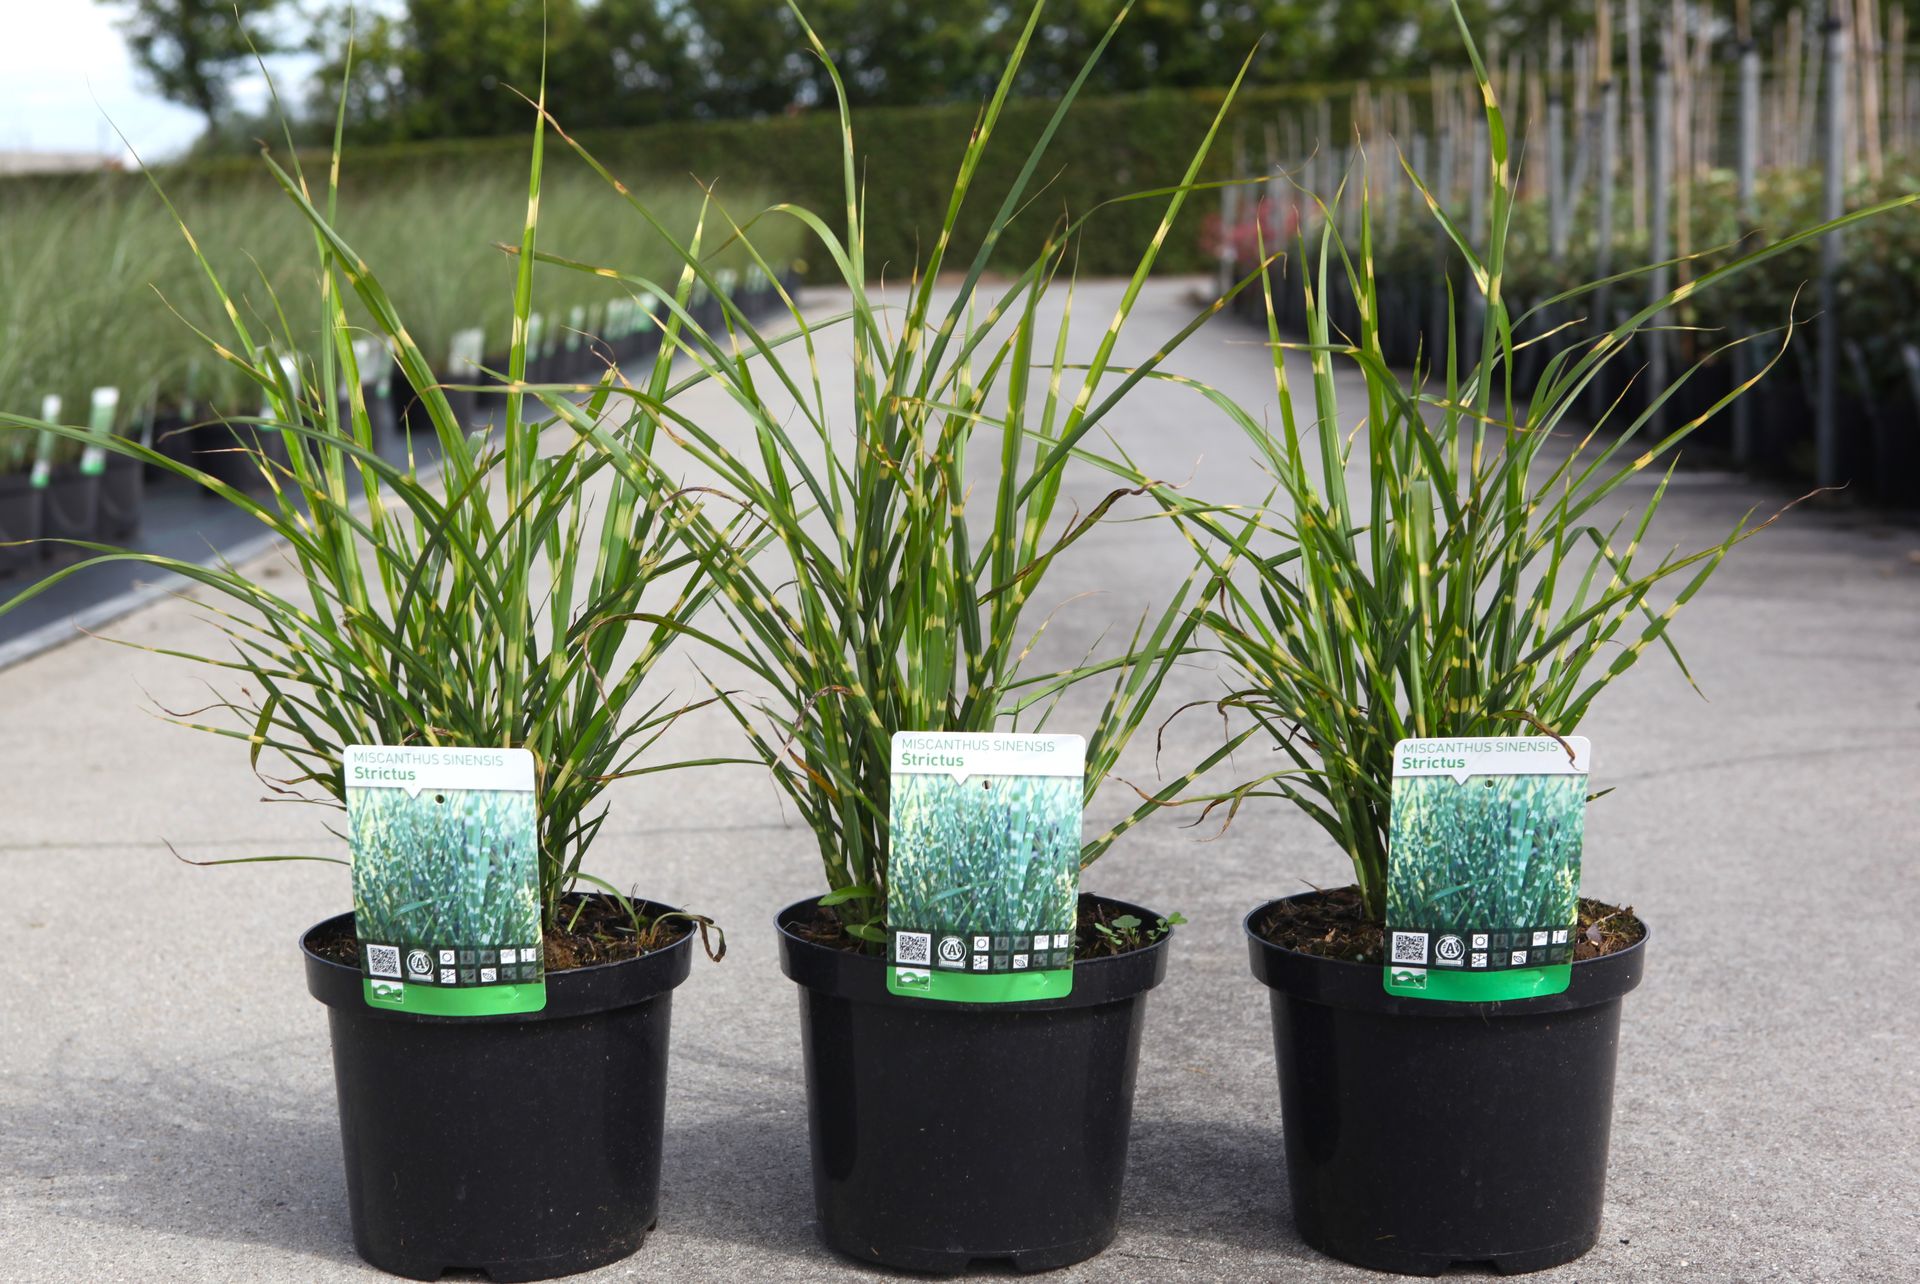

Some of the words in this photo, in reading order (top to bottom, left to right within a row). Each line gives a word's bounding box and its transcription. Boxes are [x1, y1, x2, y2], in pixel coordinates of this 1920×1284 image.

[902, 738, 990, 751] MISCANTHUS
[993, 740, 1055, 752] SINENSIS
[1403, 742, 1492, 754] MISCANTHUS
[1495, 741, 1558, 753] SINENSIS
[353, 752, 440, 766] MISCANTHUS
[443, 754, 504, 767] SINENSIS
[901, 753, 964, 766] Strictus
[1402, 756, 1465, 769] Strictus
[354, 766, 416, 780] Strictus
